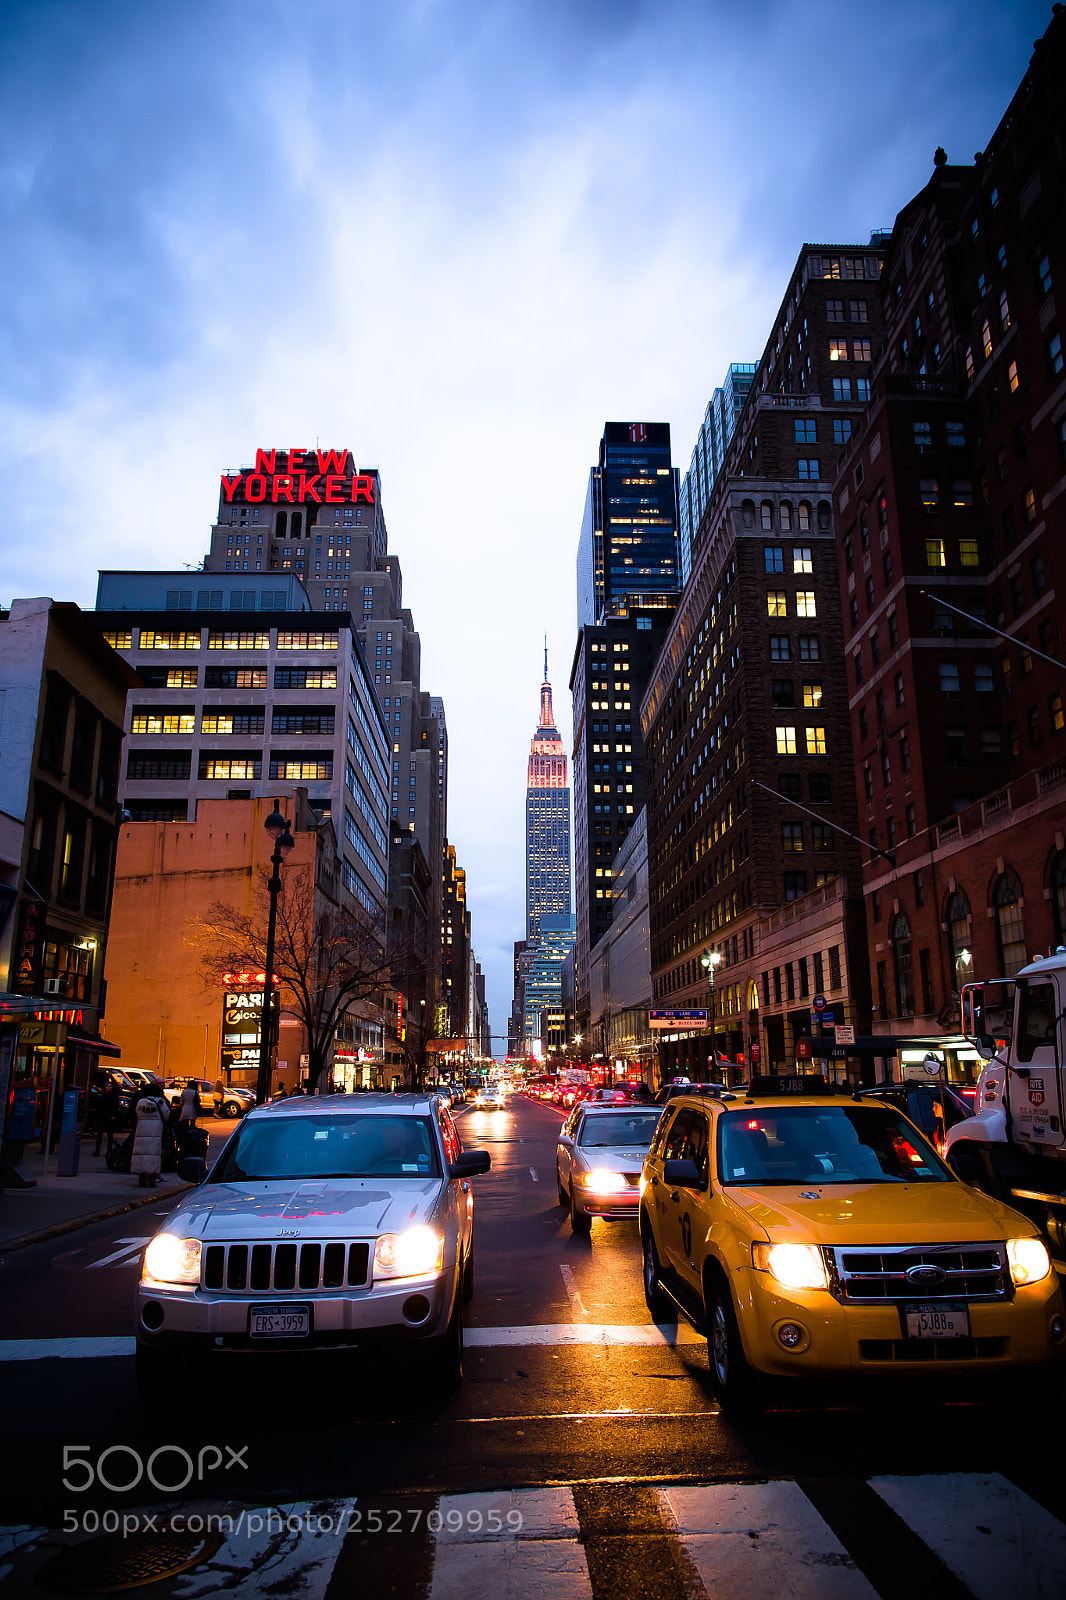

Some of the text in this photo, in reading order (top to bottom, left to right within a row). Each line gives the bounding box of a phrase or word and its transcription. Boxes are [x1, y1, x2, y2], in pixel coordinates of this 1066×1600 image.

[254, 448, 348, 475] NEW
[220, 474, 375, 503] YORKER
[20, 904, 38, 972] ALPHA
[780, 1080, 804, 1092] 5J88
[1029, 1079, 1043, 1089] RITE
[1031, 1092, 1043, 1103] AID
[276, 1228, 301, 1237] Jeep
